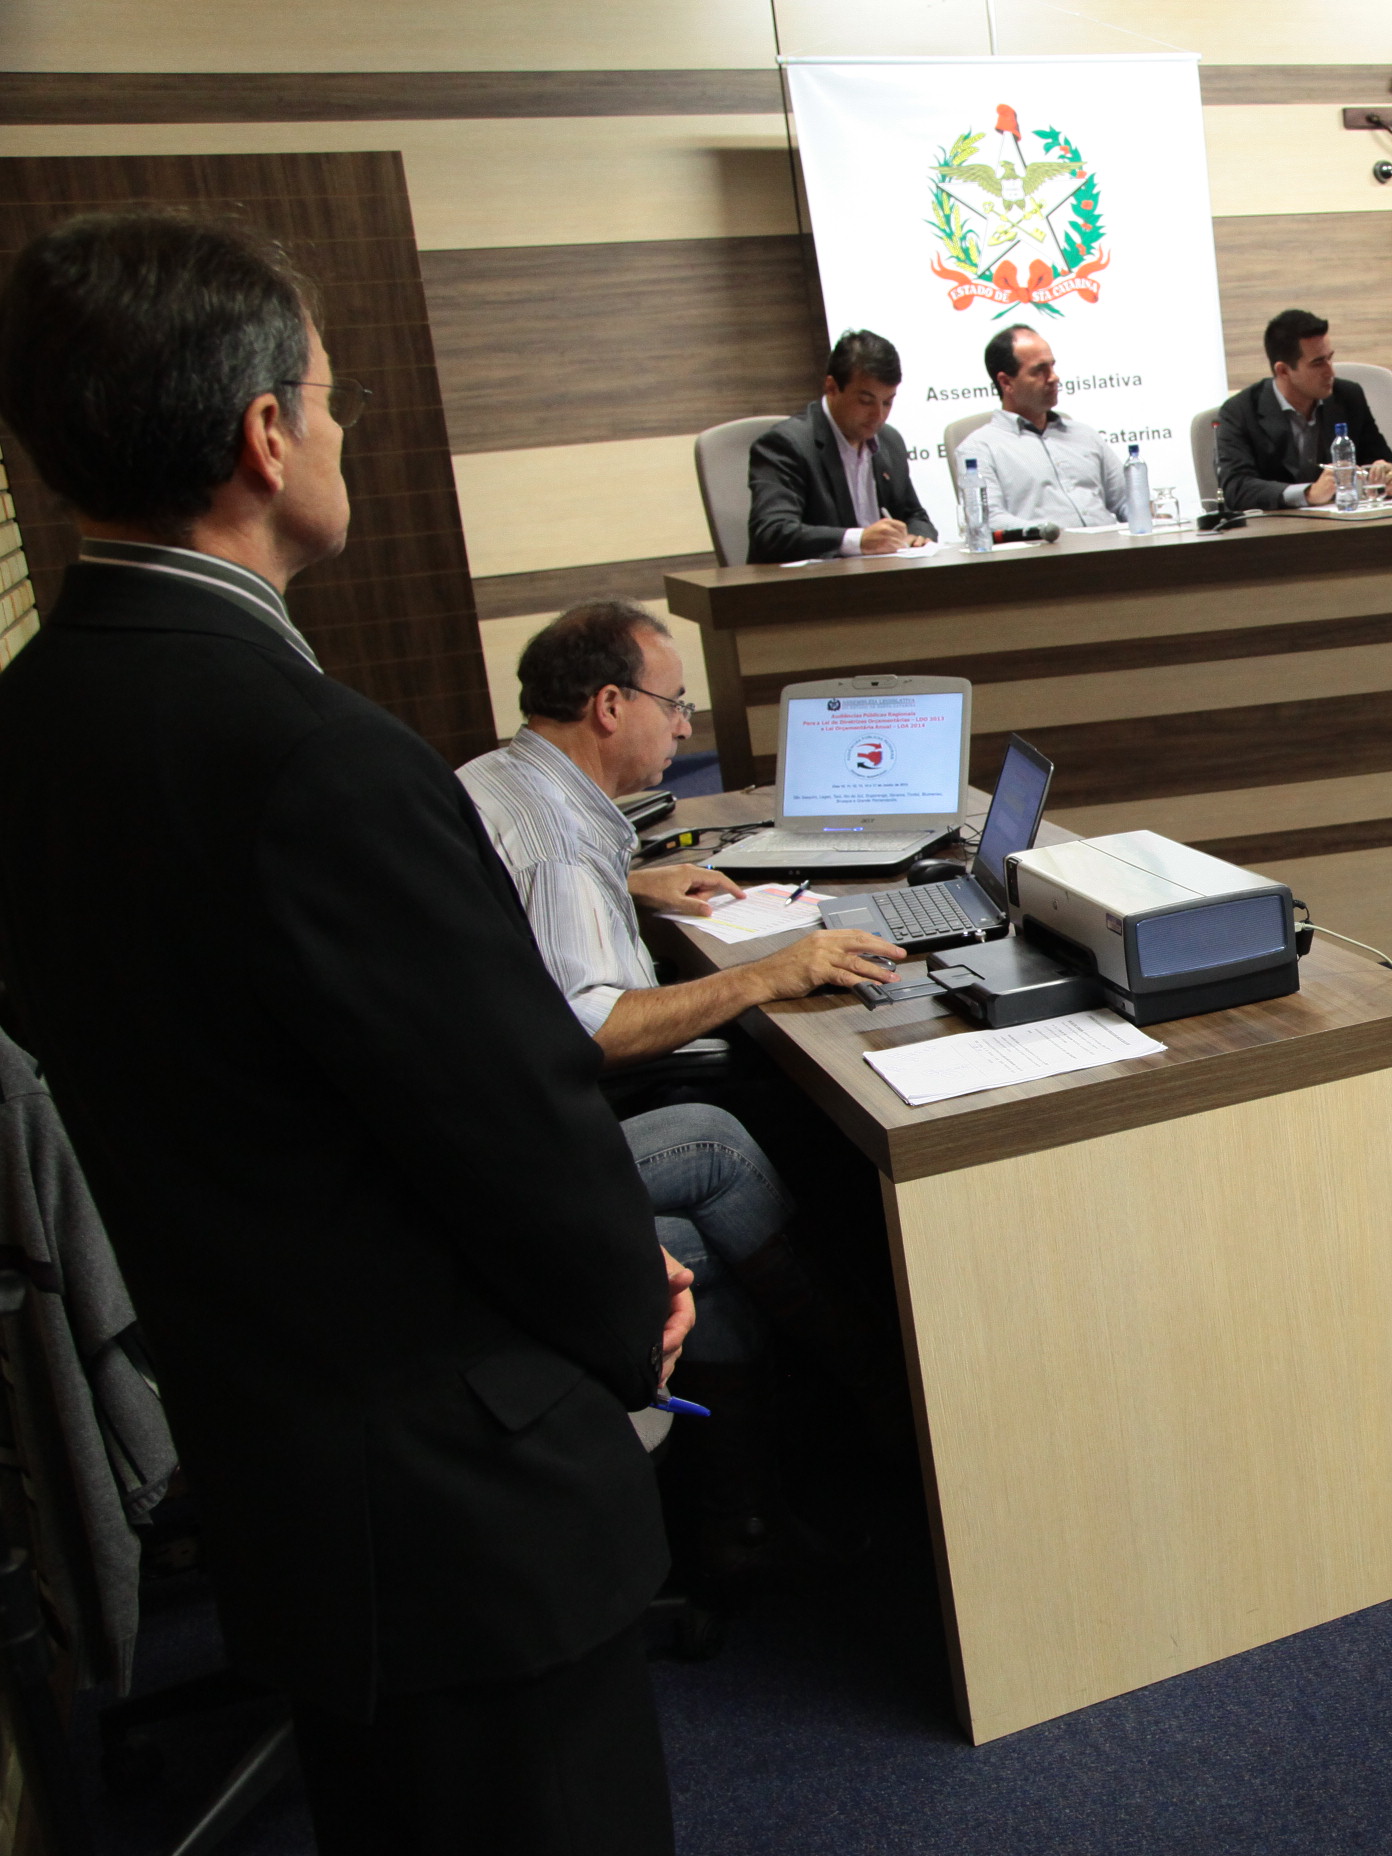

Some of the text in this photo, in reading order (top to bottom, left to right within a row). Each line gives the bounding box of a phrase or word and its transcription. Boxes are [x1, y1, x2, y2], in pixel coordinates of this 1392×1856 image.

[950, 284, 993, 300] ESTADO
[994, 289, 1012, 302] DE
[1056, 373, 1143, 395] egislativa
[906, 446, 930, 461] do
